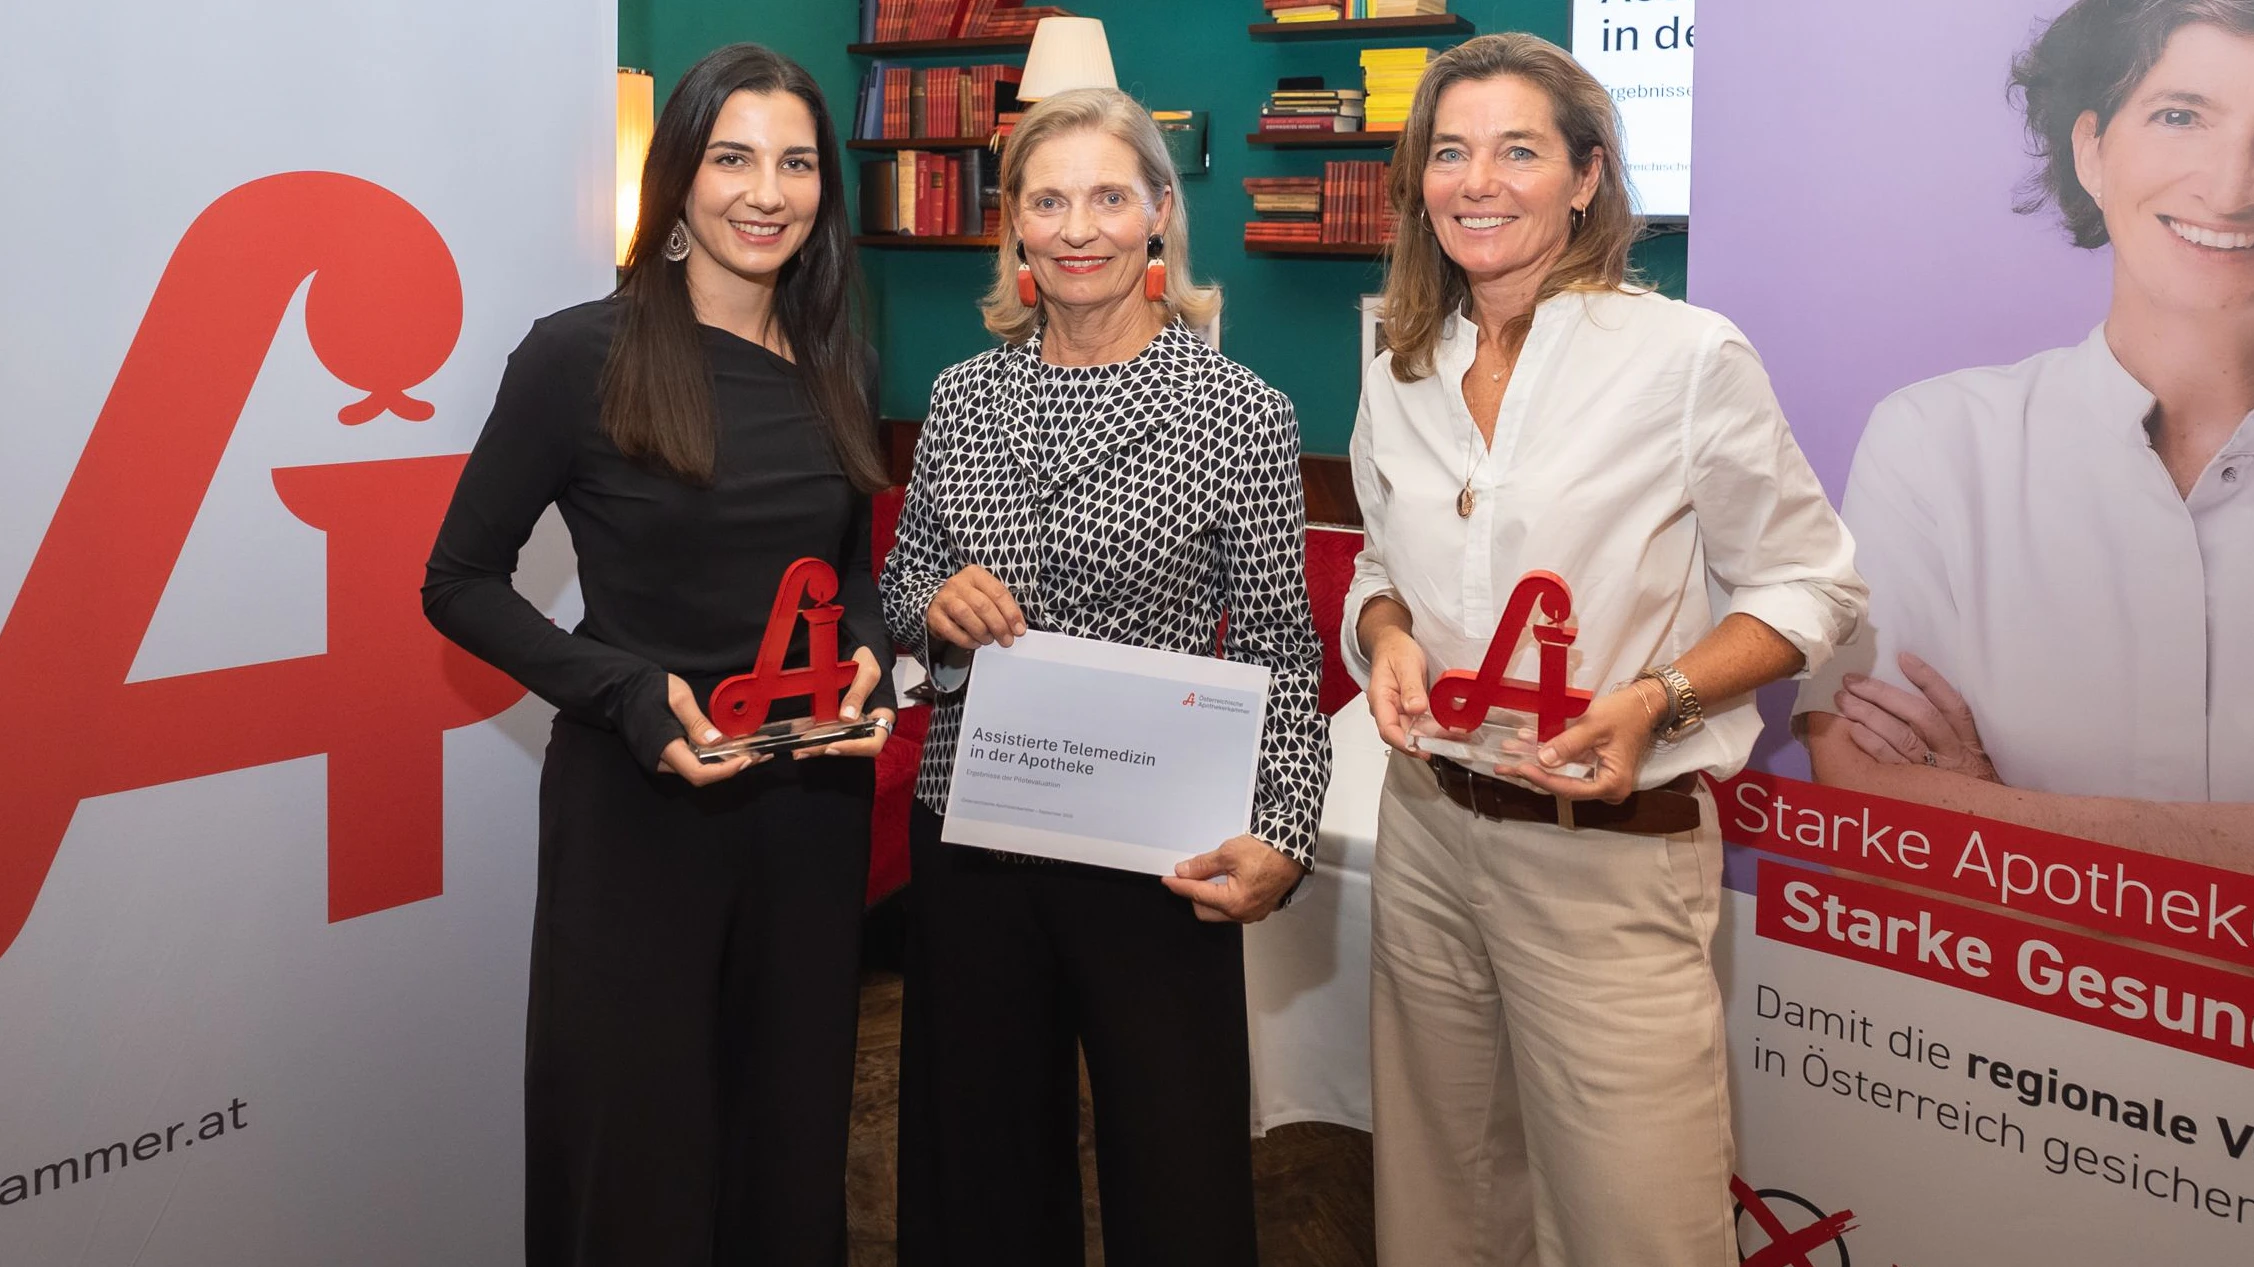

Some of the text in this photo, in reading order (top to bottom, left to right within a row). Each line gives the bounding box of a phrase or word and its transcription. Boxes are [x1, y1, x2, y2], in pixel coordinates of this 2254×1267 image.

[1603, 18, 1638, 51] in
[1604, 83, 1693, 102] rgebnisse
[970, 744, 1095, 776] in der Apotheke
[972, 727, 1156, 767] Assistierte Telemedizin
[1734, 782, 2254, 948] Starke Apothek
[1782, 881, 2254, 1049] Starke Gesun
[1754, 1038, 1785, 1078] in
[1802, 1045, 2025, 1154] Österreich
[1757, 984, 1874, 1048] Damit
[1889, 1025, 1951, 1070] die
[1967, 1052, 2198, 1145] regionale
[0, 1098, 248, 1206] ammer.at
